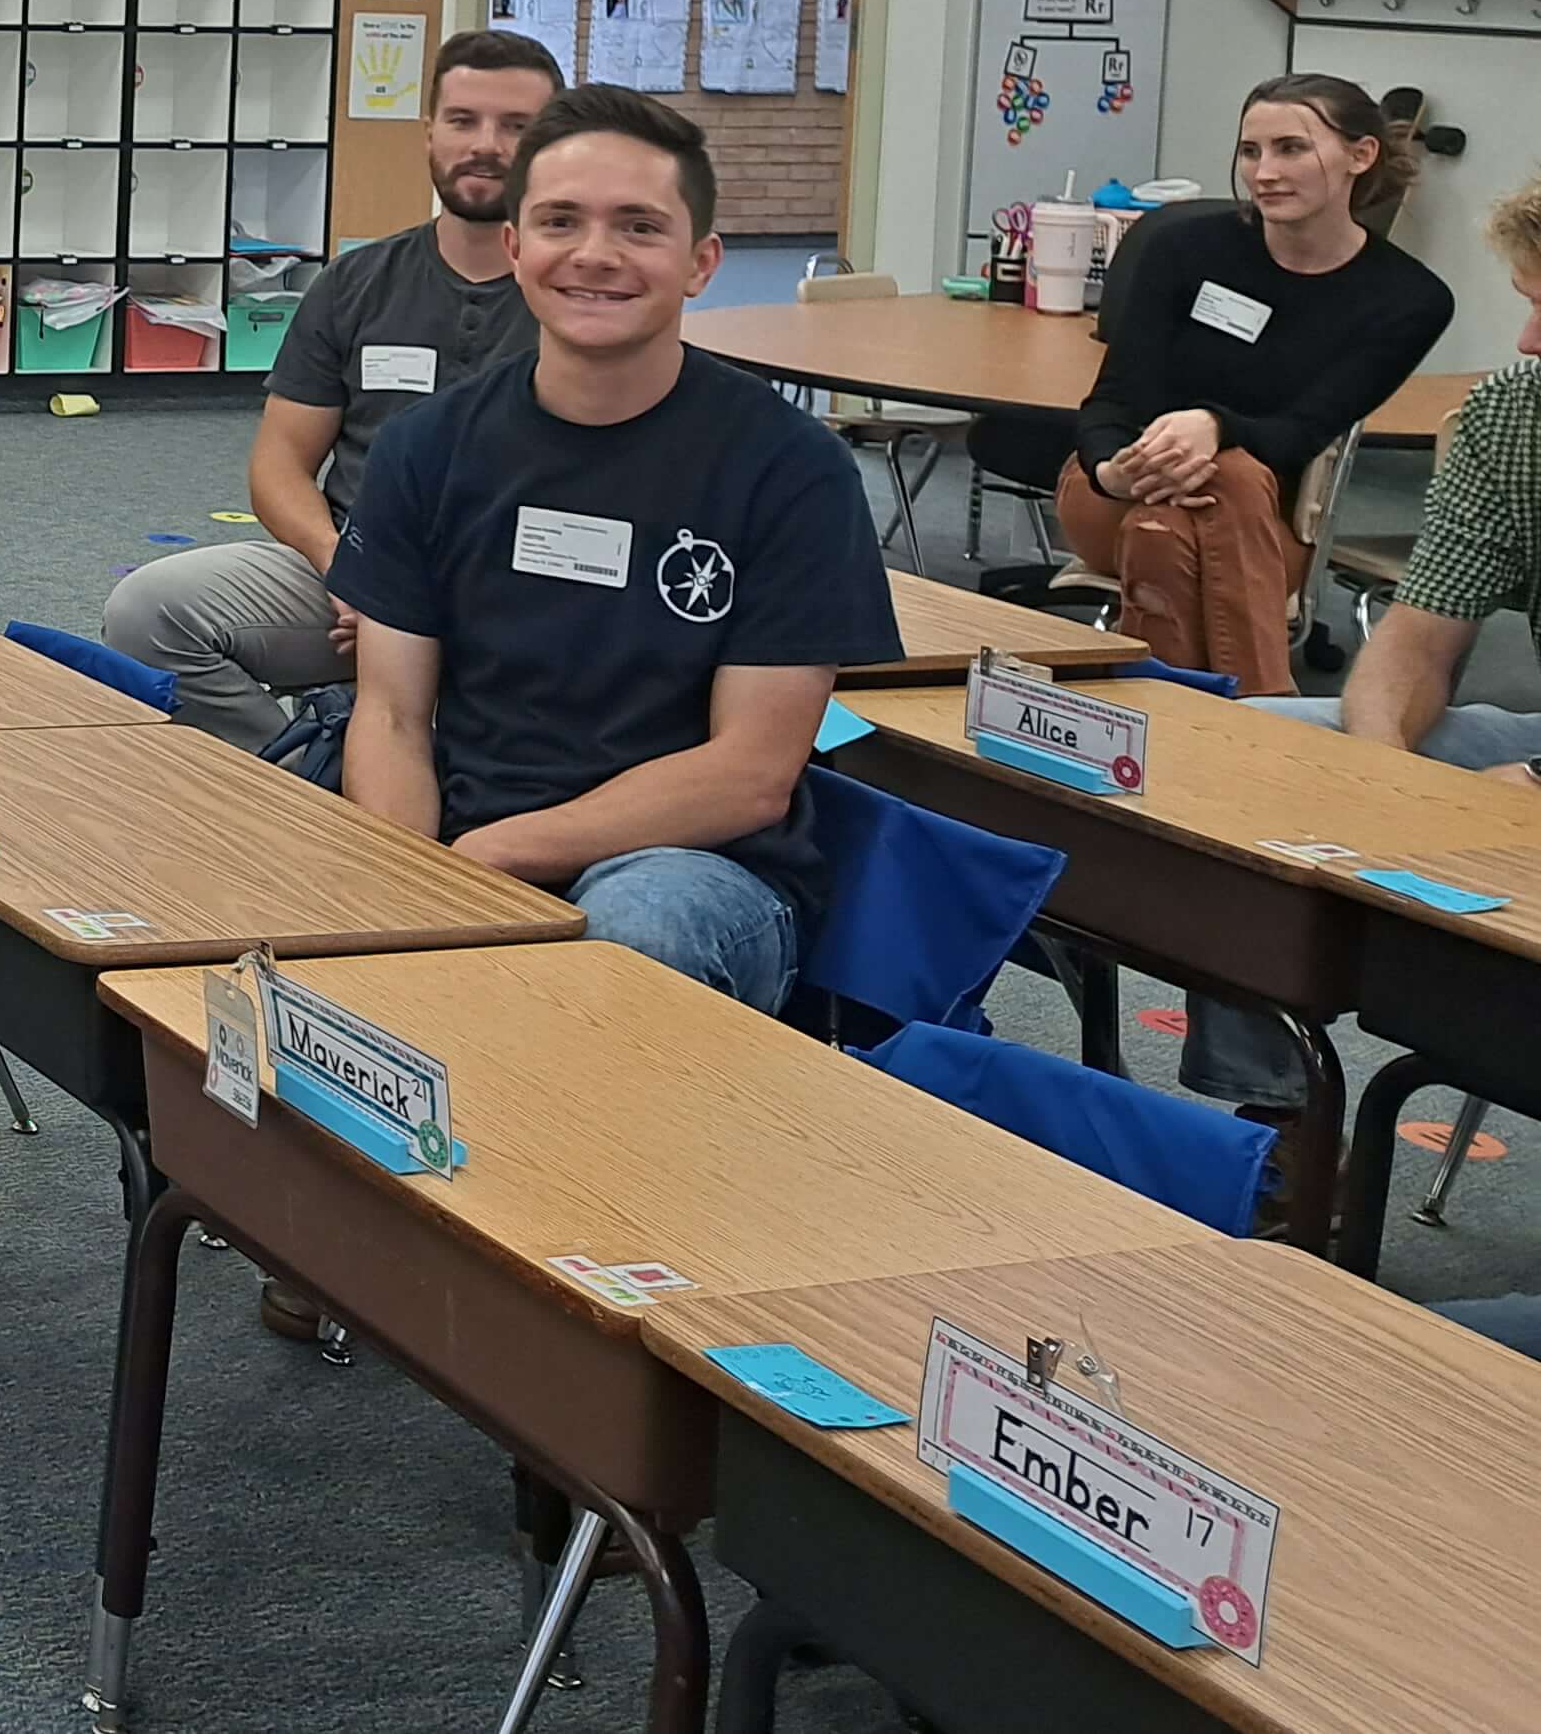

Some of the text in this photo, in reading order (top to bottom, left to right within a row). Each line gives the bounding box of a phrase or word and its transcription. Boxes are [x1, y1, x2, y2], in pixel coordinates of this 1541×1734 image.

[1108, 57, 1123, 72] Rr
[1018, 705, 1078, 748] Alice
[1106, 724, 1115, 740] 4
[288, 1010, 411, 1122] Maverick
[992, 1406, 1152, 1546] Ember
[1186, 1507, 1214, 1547] 17
